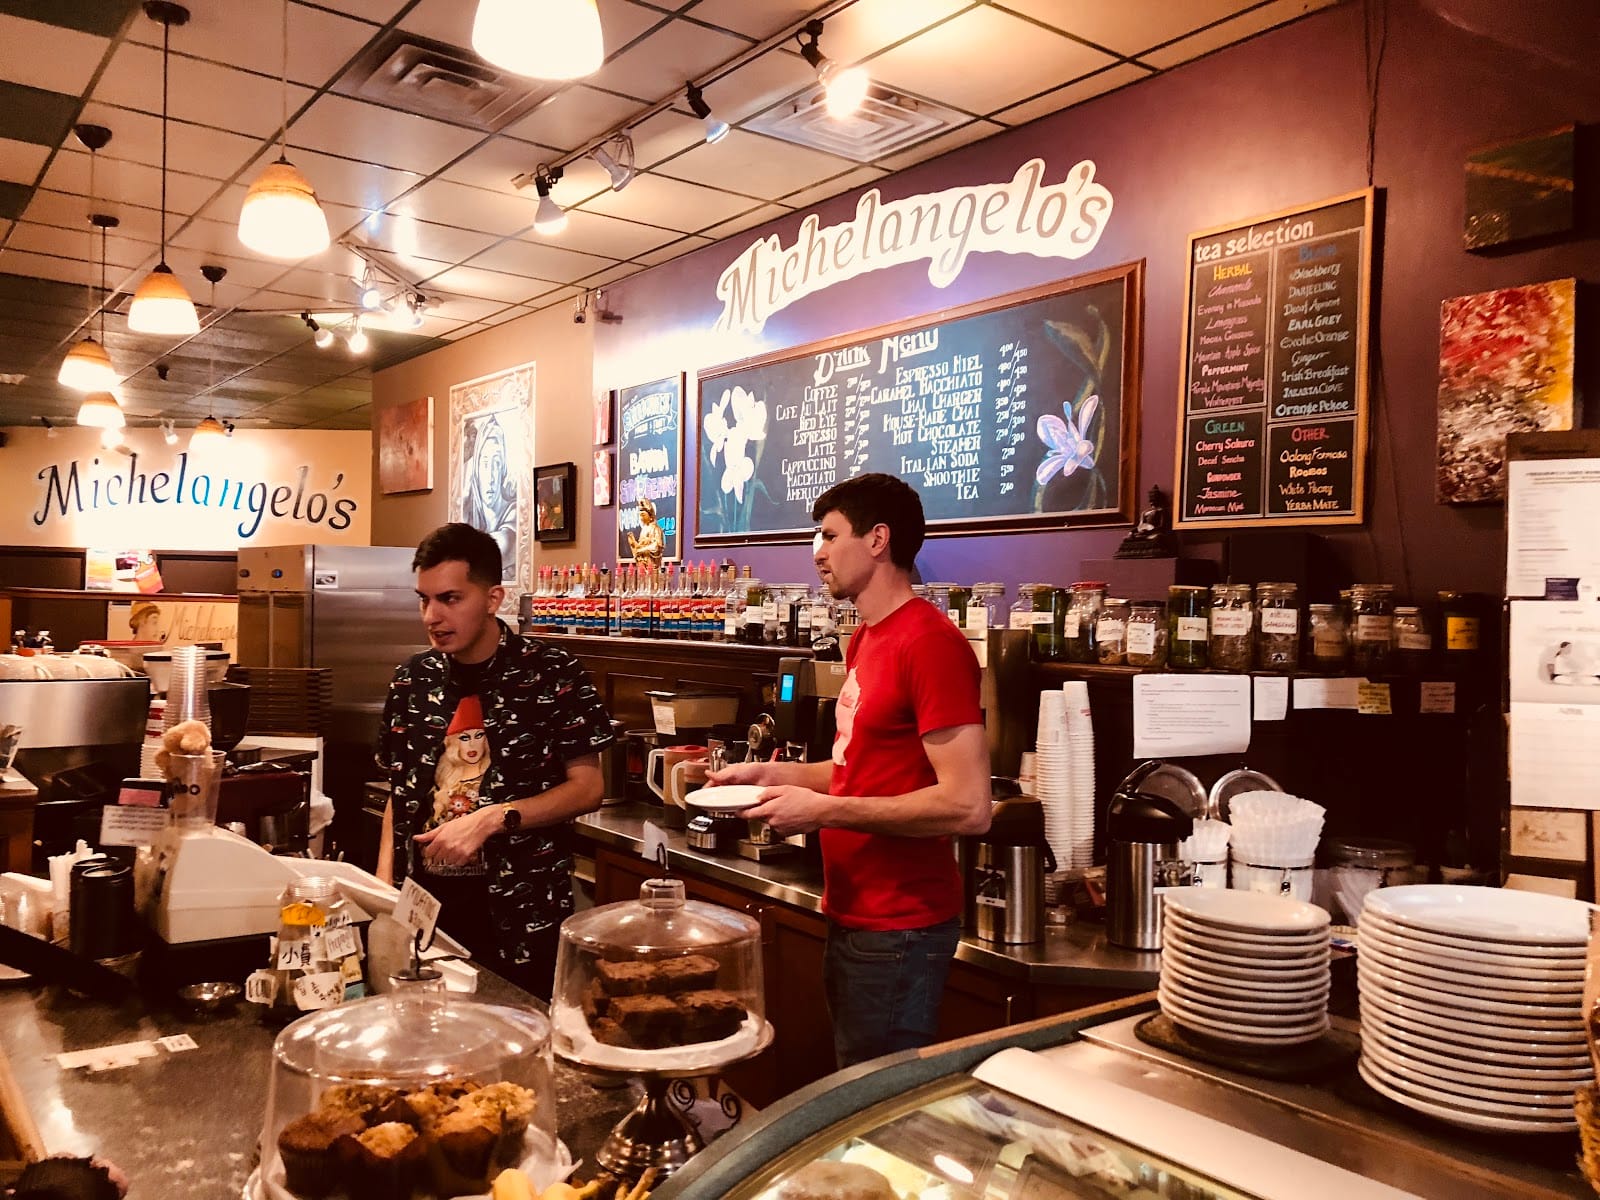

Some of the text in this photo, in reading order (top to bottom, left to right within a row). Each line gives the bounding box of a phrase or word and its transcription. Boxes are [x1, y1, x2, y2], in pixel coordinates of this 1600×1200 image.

[716, 161, 1108, 331] Michelangelo's
[1194, 218, 1314, 262] tea selection
[1213, 262, 1253, 281] HERBAL
[1287, 313, 1342, 332] EARL GREY
[1280, 330, 1350, 349] Exotic Orange
[813, 345, 872, 387] Drink
[877, 327, 939, 374] Menu
[895, 361, 949, 387] ESPRESSO
[1281, 364, 1350, 383] Irish Breakfast
[804, 384, 839, 403] COFFEE
[870, 384, 916, 406] CARAMEL
[919, 371, 983, 397] MACCHIATO
[776, 404, 799, 421] CAFE
[800, 400, 812, 418] AU
[813, 399, 838, 416] LAIT
[901, 396, 927, 415] CHAI
[932, 387, 983, 409] CHARGER
[1275, 399, 1350, 417] Orange Pekoe
[800, 414, 817, 432] RED
[818, 412, 838, 429] EYE
[882, 407, 947, 433] HOUSE-MADE
[951, 404, 981, 422] CHAI
[1204, 419, 1245, 435] GREEN
[793, 427, 838, 447] ESPRESSO
[892, 429, 914, 446] HOT
[917, 418, 982, 442] CHOCOLATE
[1291, 427, 1330, 443] OTHER
[808, 440, 837, 458] LATTE
[930, 435, 982, 457] STEAMER
[1195, 437, 1256, 453] Cherry Sakura
[781, 455, 837, 476] CAPPUCCINO
[900, 455, 947, 476] ITALIAN
[950, 451, 980, 469] SODA
[1279, 446, 1348, 466] Oolong Formosa
[786, 470, 836, 488] MACCHIATO
[923, 467, 981, 488] SMOOTHIE
[33, 452, 357, 539] Michelangelo's
[786, 484, 835, 502] AMERICAN
[955, 482, 980, 501] TEA
[1196, 486, 1243, 500] Jasmine
[1285, 498, 1340, 512] YERBA MATE
